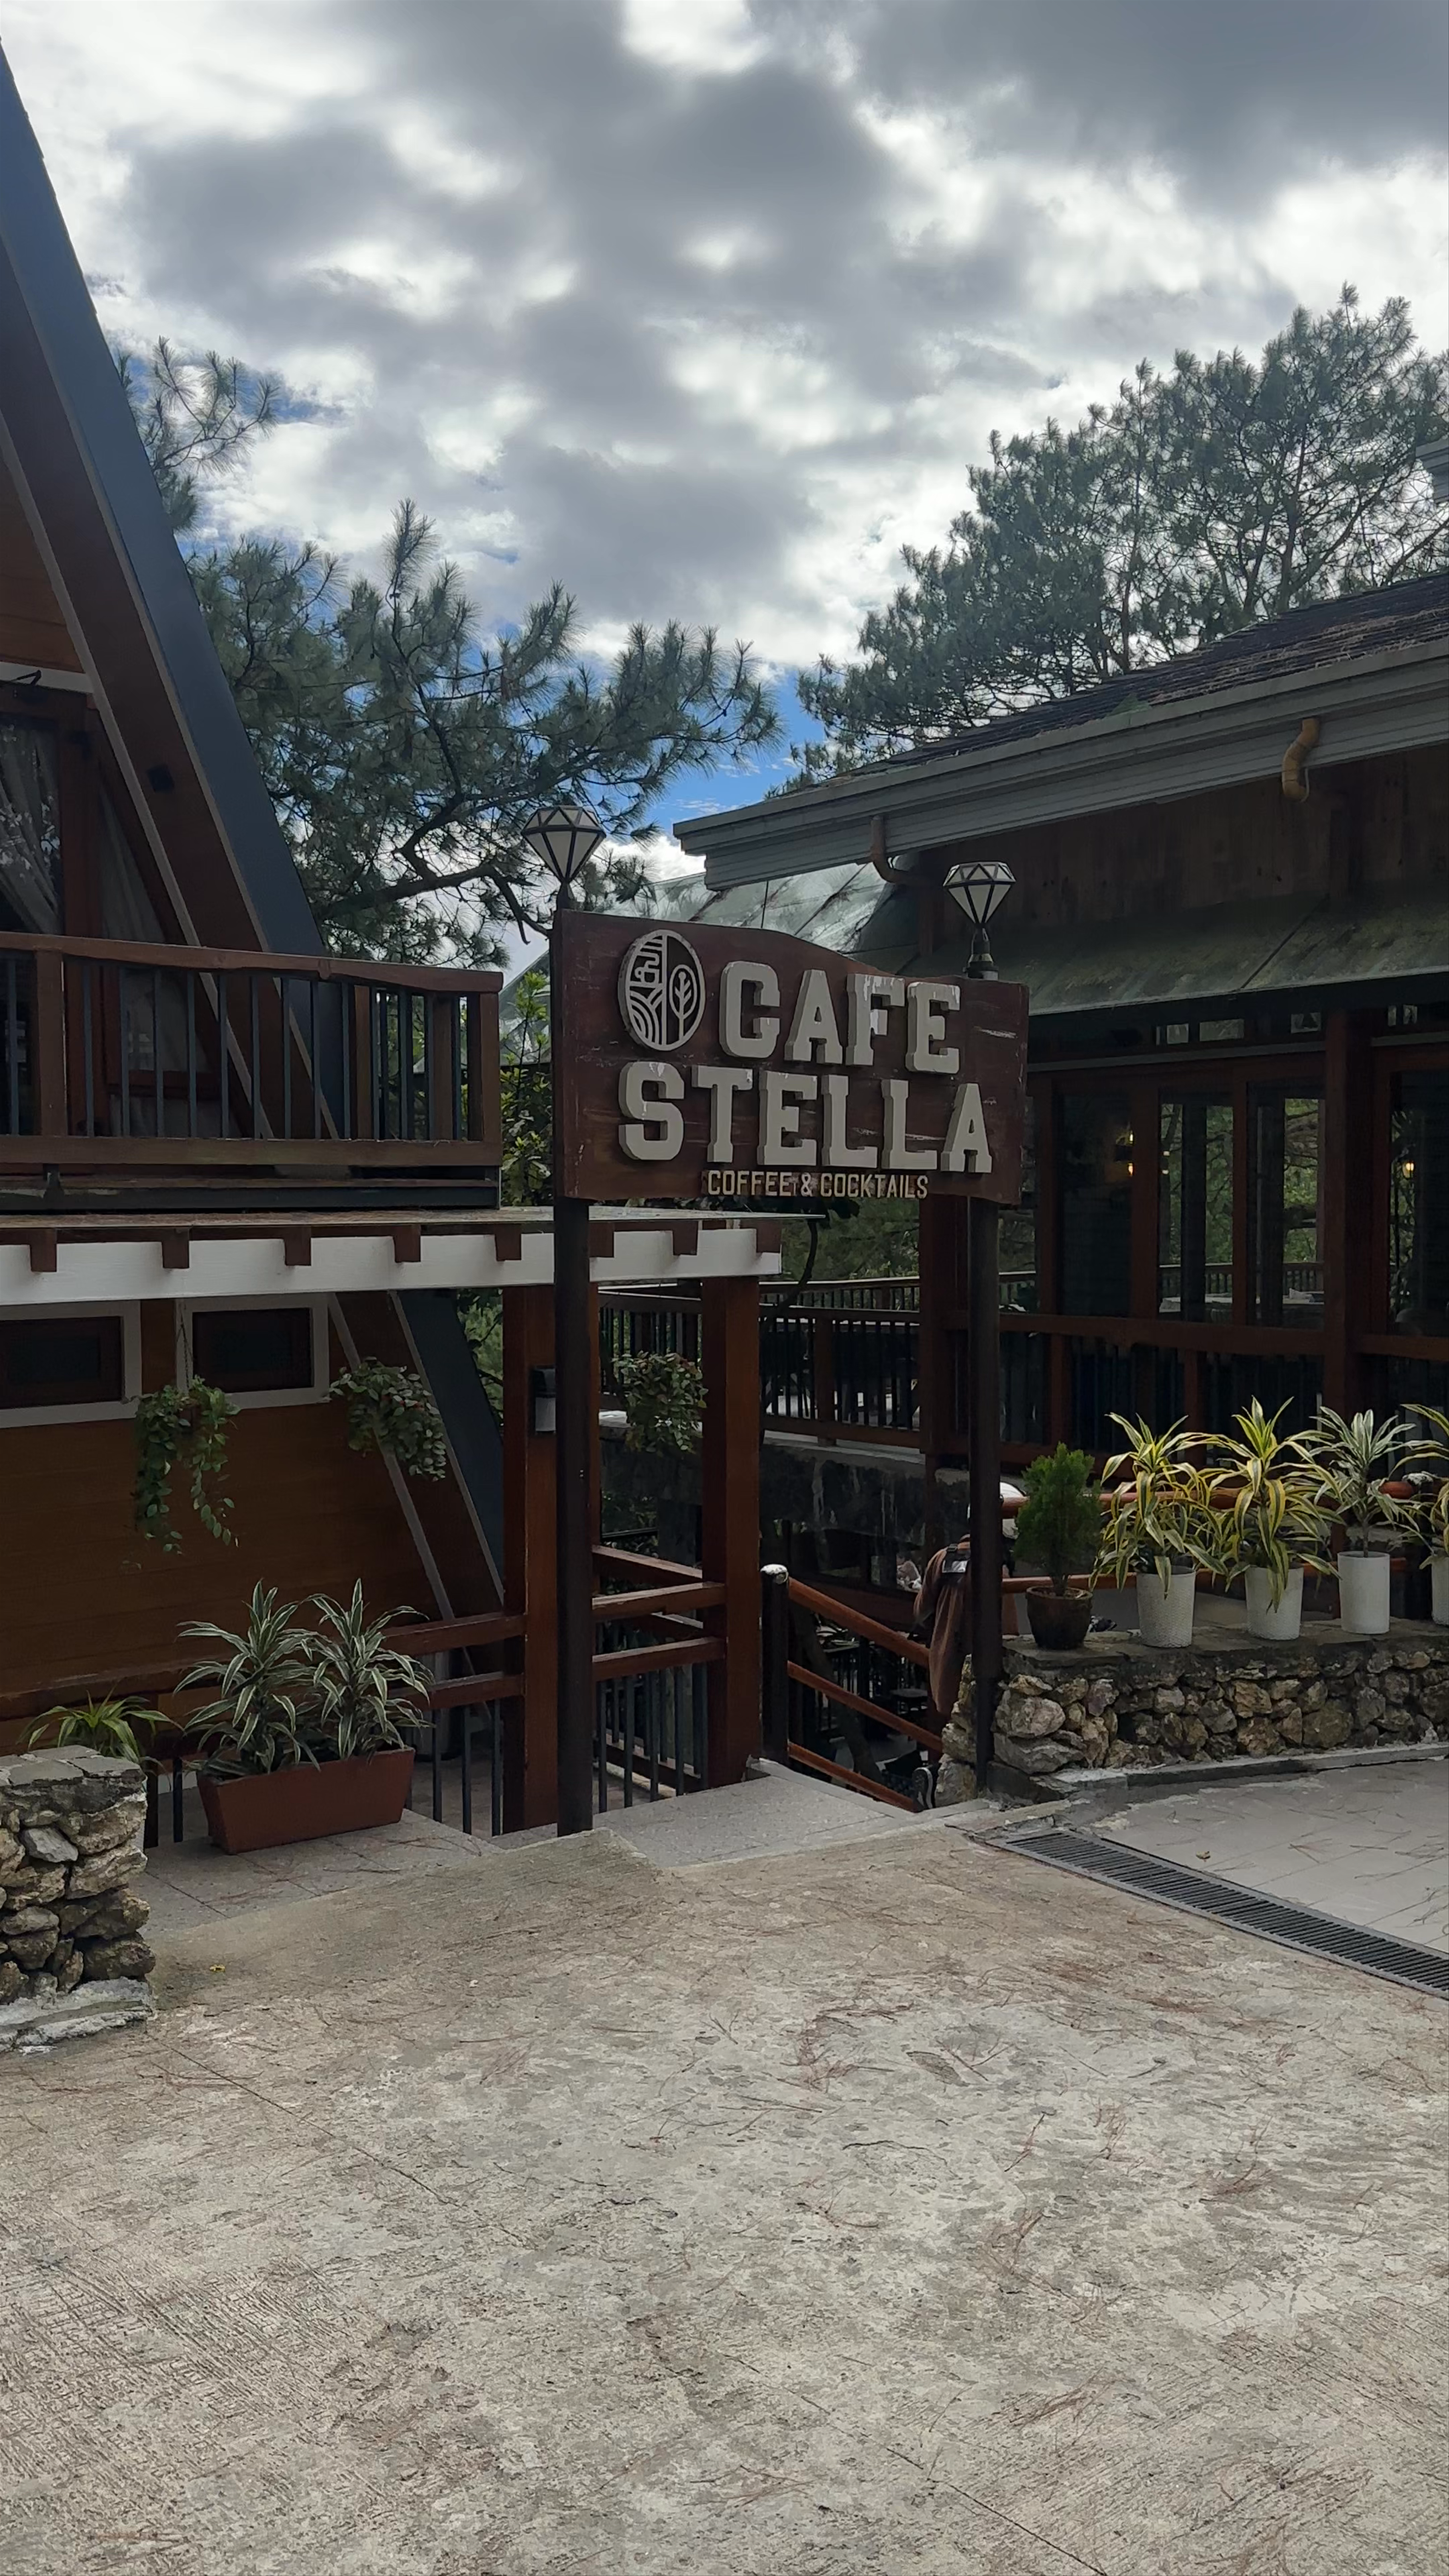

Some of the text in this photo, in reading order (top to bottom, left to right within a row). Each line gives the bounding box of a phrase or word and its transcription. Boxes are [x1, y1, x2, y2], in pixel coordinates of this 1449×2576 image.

[720, 961, 961, 1074] CAFE
[618, 1061, 992, 1173] STELLA
[708, 1170, 928, 1199] COFFEE & COCKTAILS
